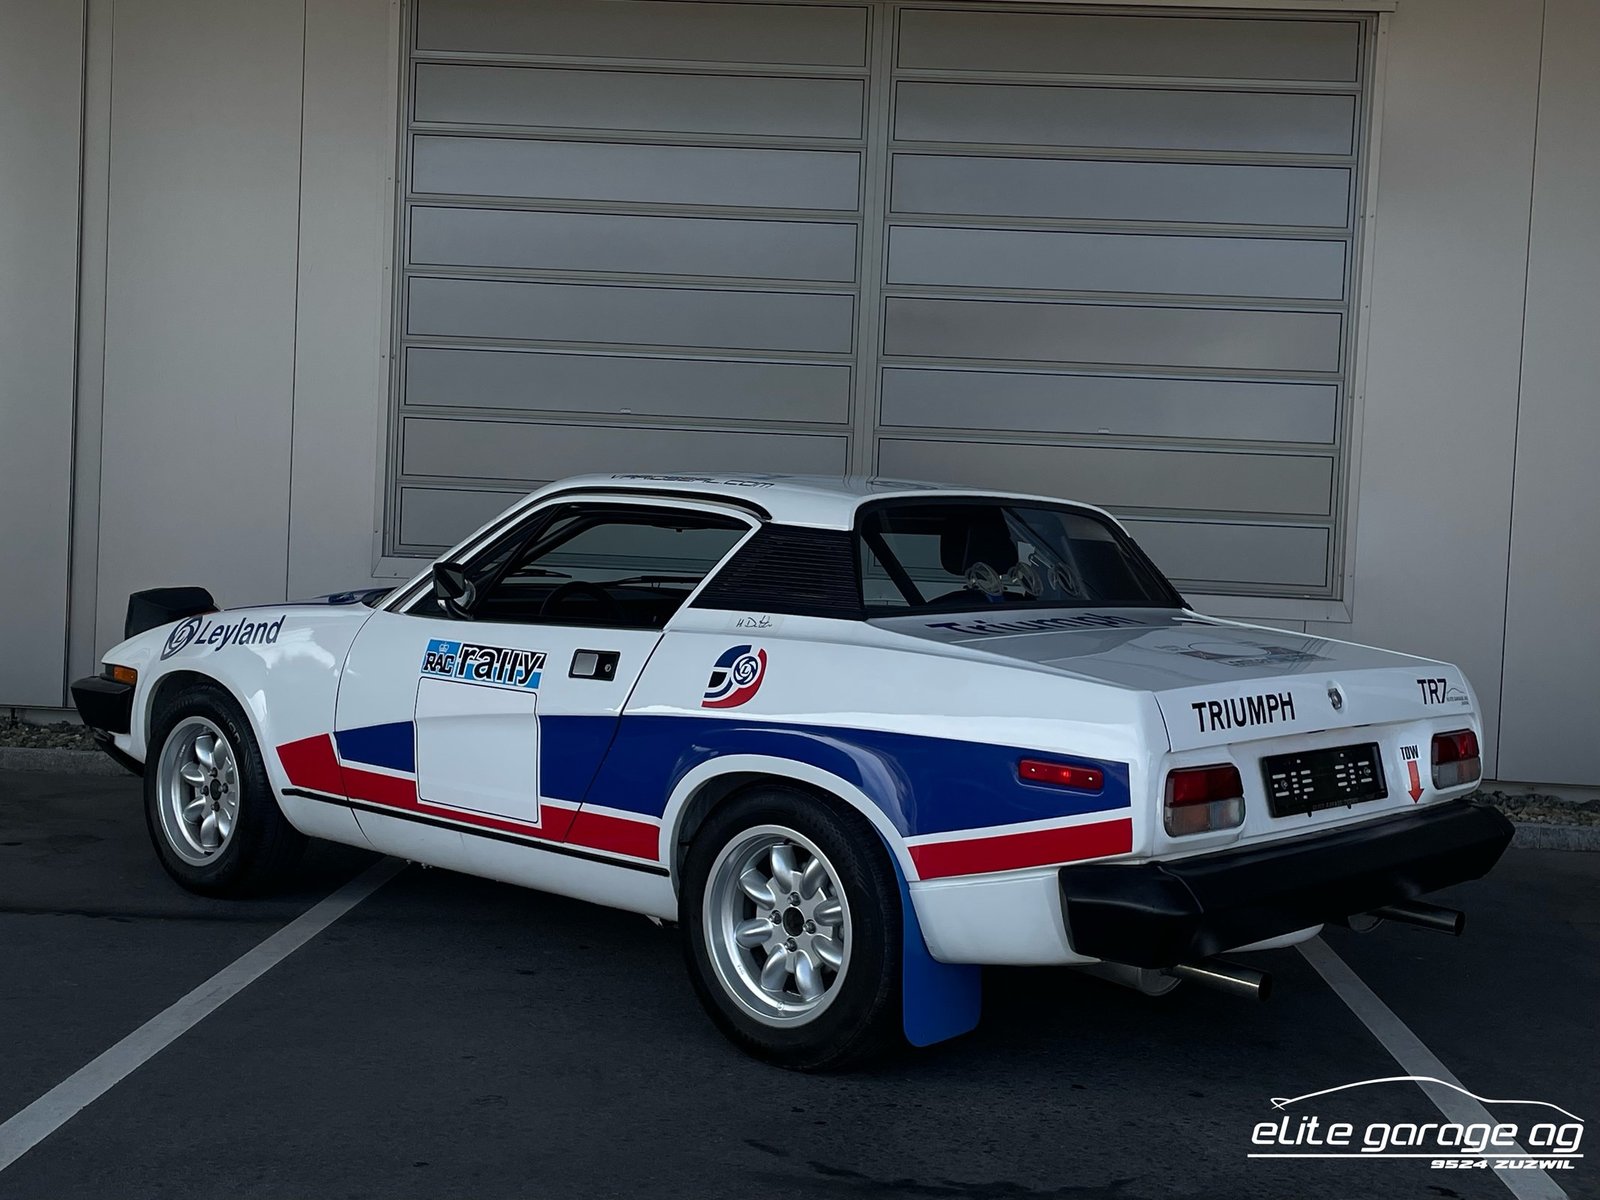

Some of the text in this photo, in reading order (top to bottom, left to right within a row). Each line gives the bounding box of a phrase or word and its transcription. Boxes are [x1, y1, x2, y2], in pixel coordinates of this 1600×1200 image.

[194, 614, 286, 651] Leyland
[925, 612, 1149, 635] Triumph
[422, 646, 545, 686] RAC rally
[1416, 678, 1447, 705] TR7
[1191, 691, 1296, 733] TRIUMPH
[1400, 745, 1420, 761] TOW
